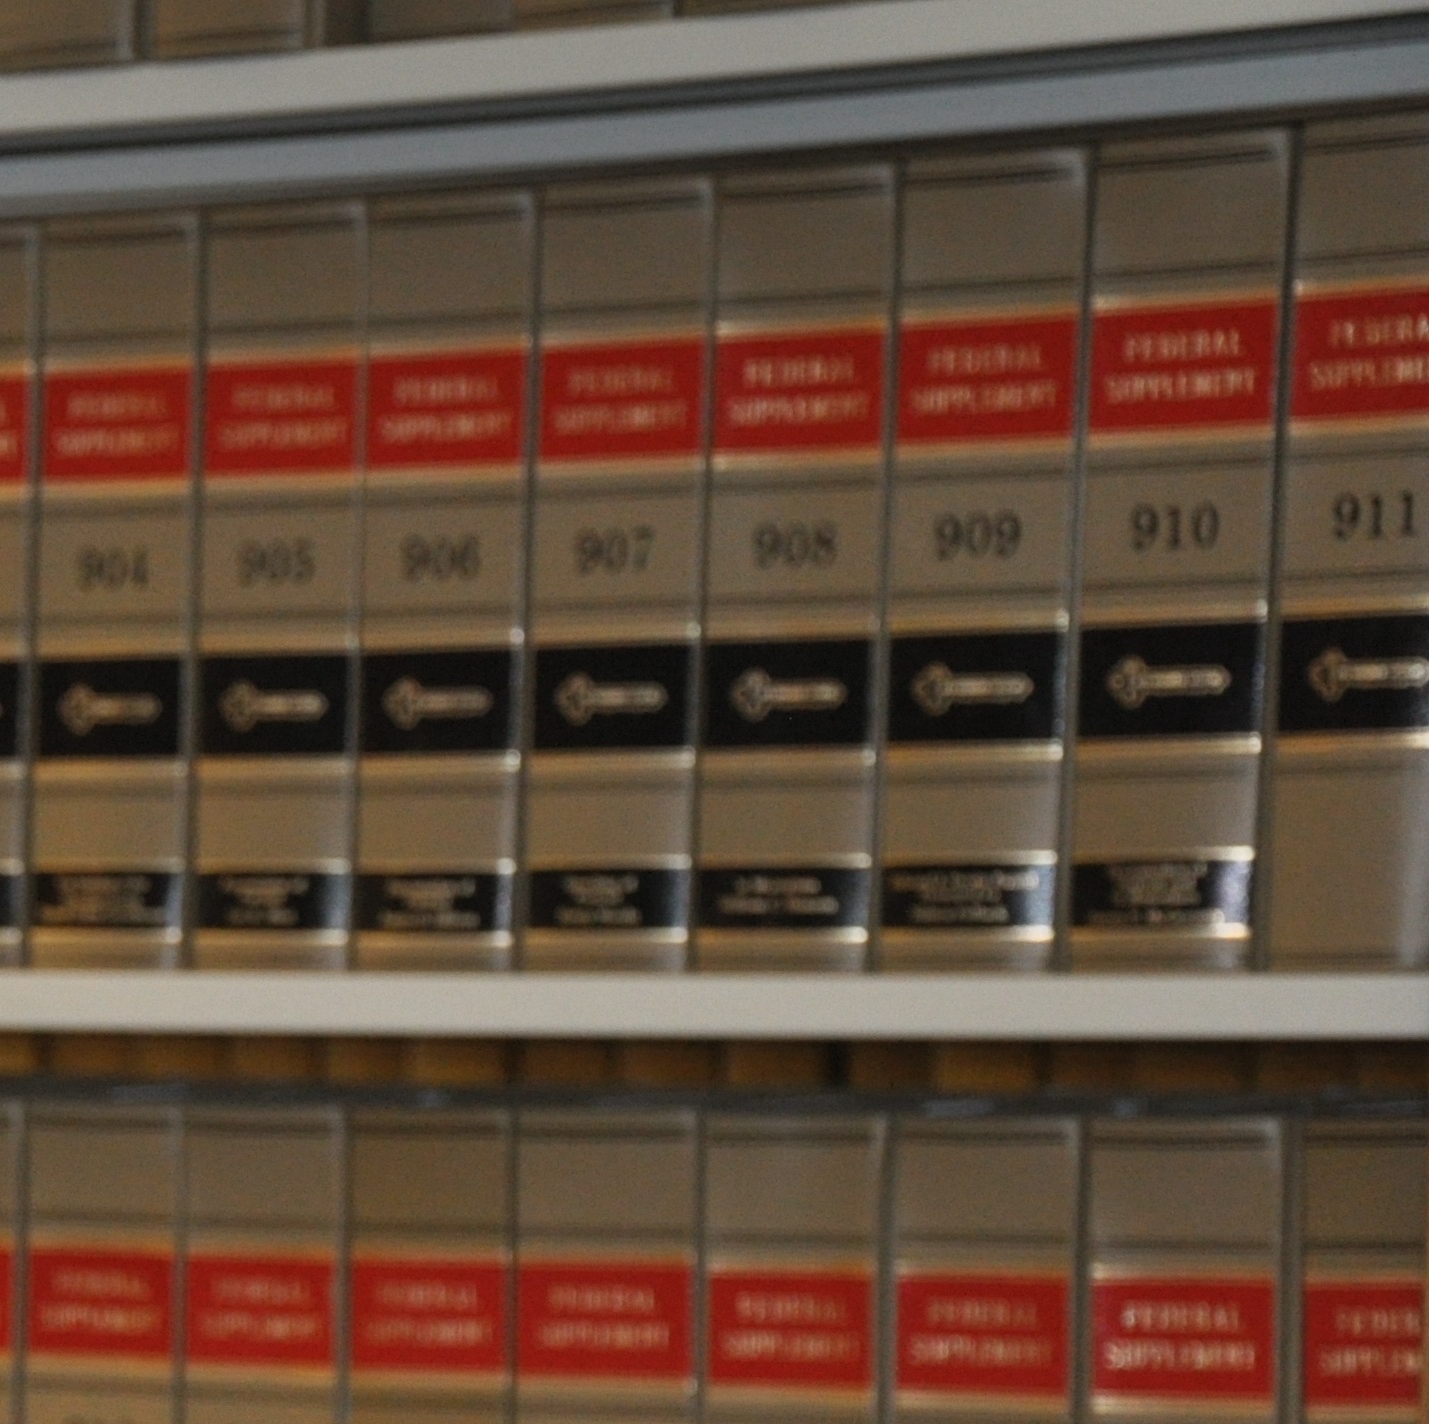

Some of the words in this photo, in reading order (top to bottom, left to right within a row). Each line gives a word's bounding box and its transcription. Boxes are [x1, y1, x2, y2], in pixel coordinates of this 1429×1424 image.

[1123, 332, 1243, 363] FEDERAL
[1329, 314, 1429, 348] FEDERA
[743, 356, 855, 385] FEDERAL
[928, 345, 1043, 374] FEDERAL
[1311, 352, 1429, 391] SUPPLEME
[912, 379, 1057, 413] SUPPLEMENT
[1106, 368, 1255, 405] SUPPLEMENT
[729, 390, 868, 425] SUPPLEMENT
[1130, 501, 1220, 554] 910
[1332, 487, 1415, 541] 911
[574, 525, 655, 574] 907
[752, 519, 838, 569] 908
[934, 509, 1022, 561] 909
[236, 537, 315, 587] 905
[400, 533, 481, 582] 906
[1121, 1299, 1240, 1333] FEDERAL
[1335, 1306, 1421, 1337] FEDER
[1106, 1339, 1255, 1370] SUPPLEMENT
